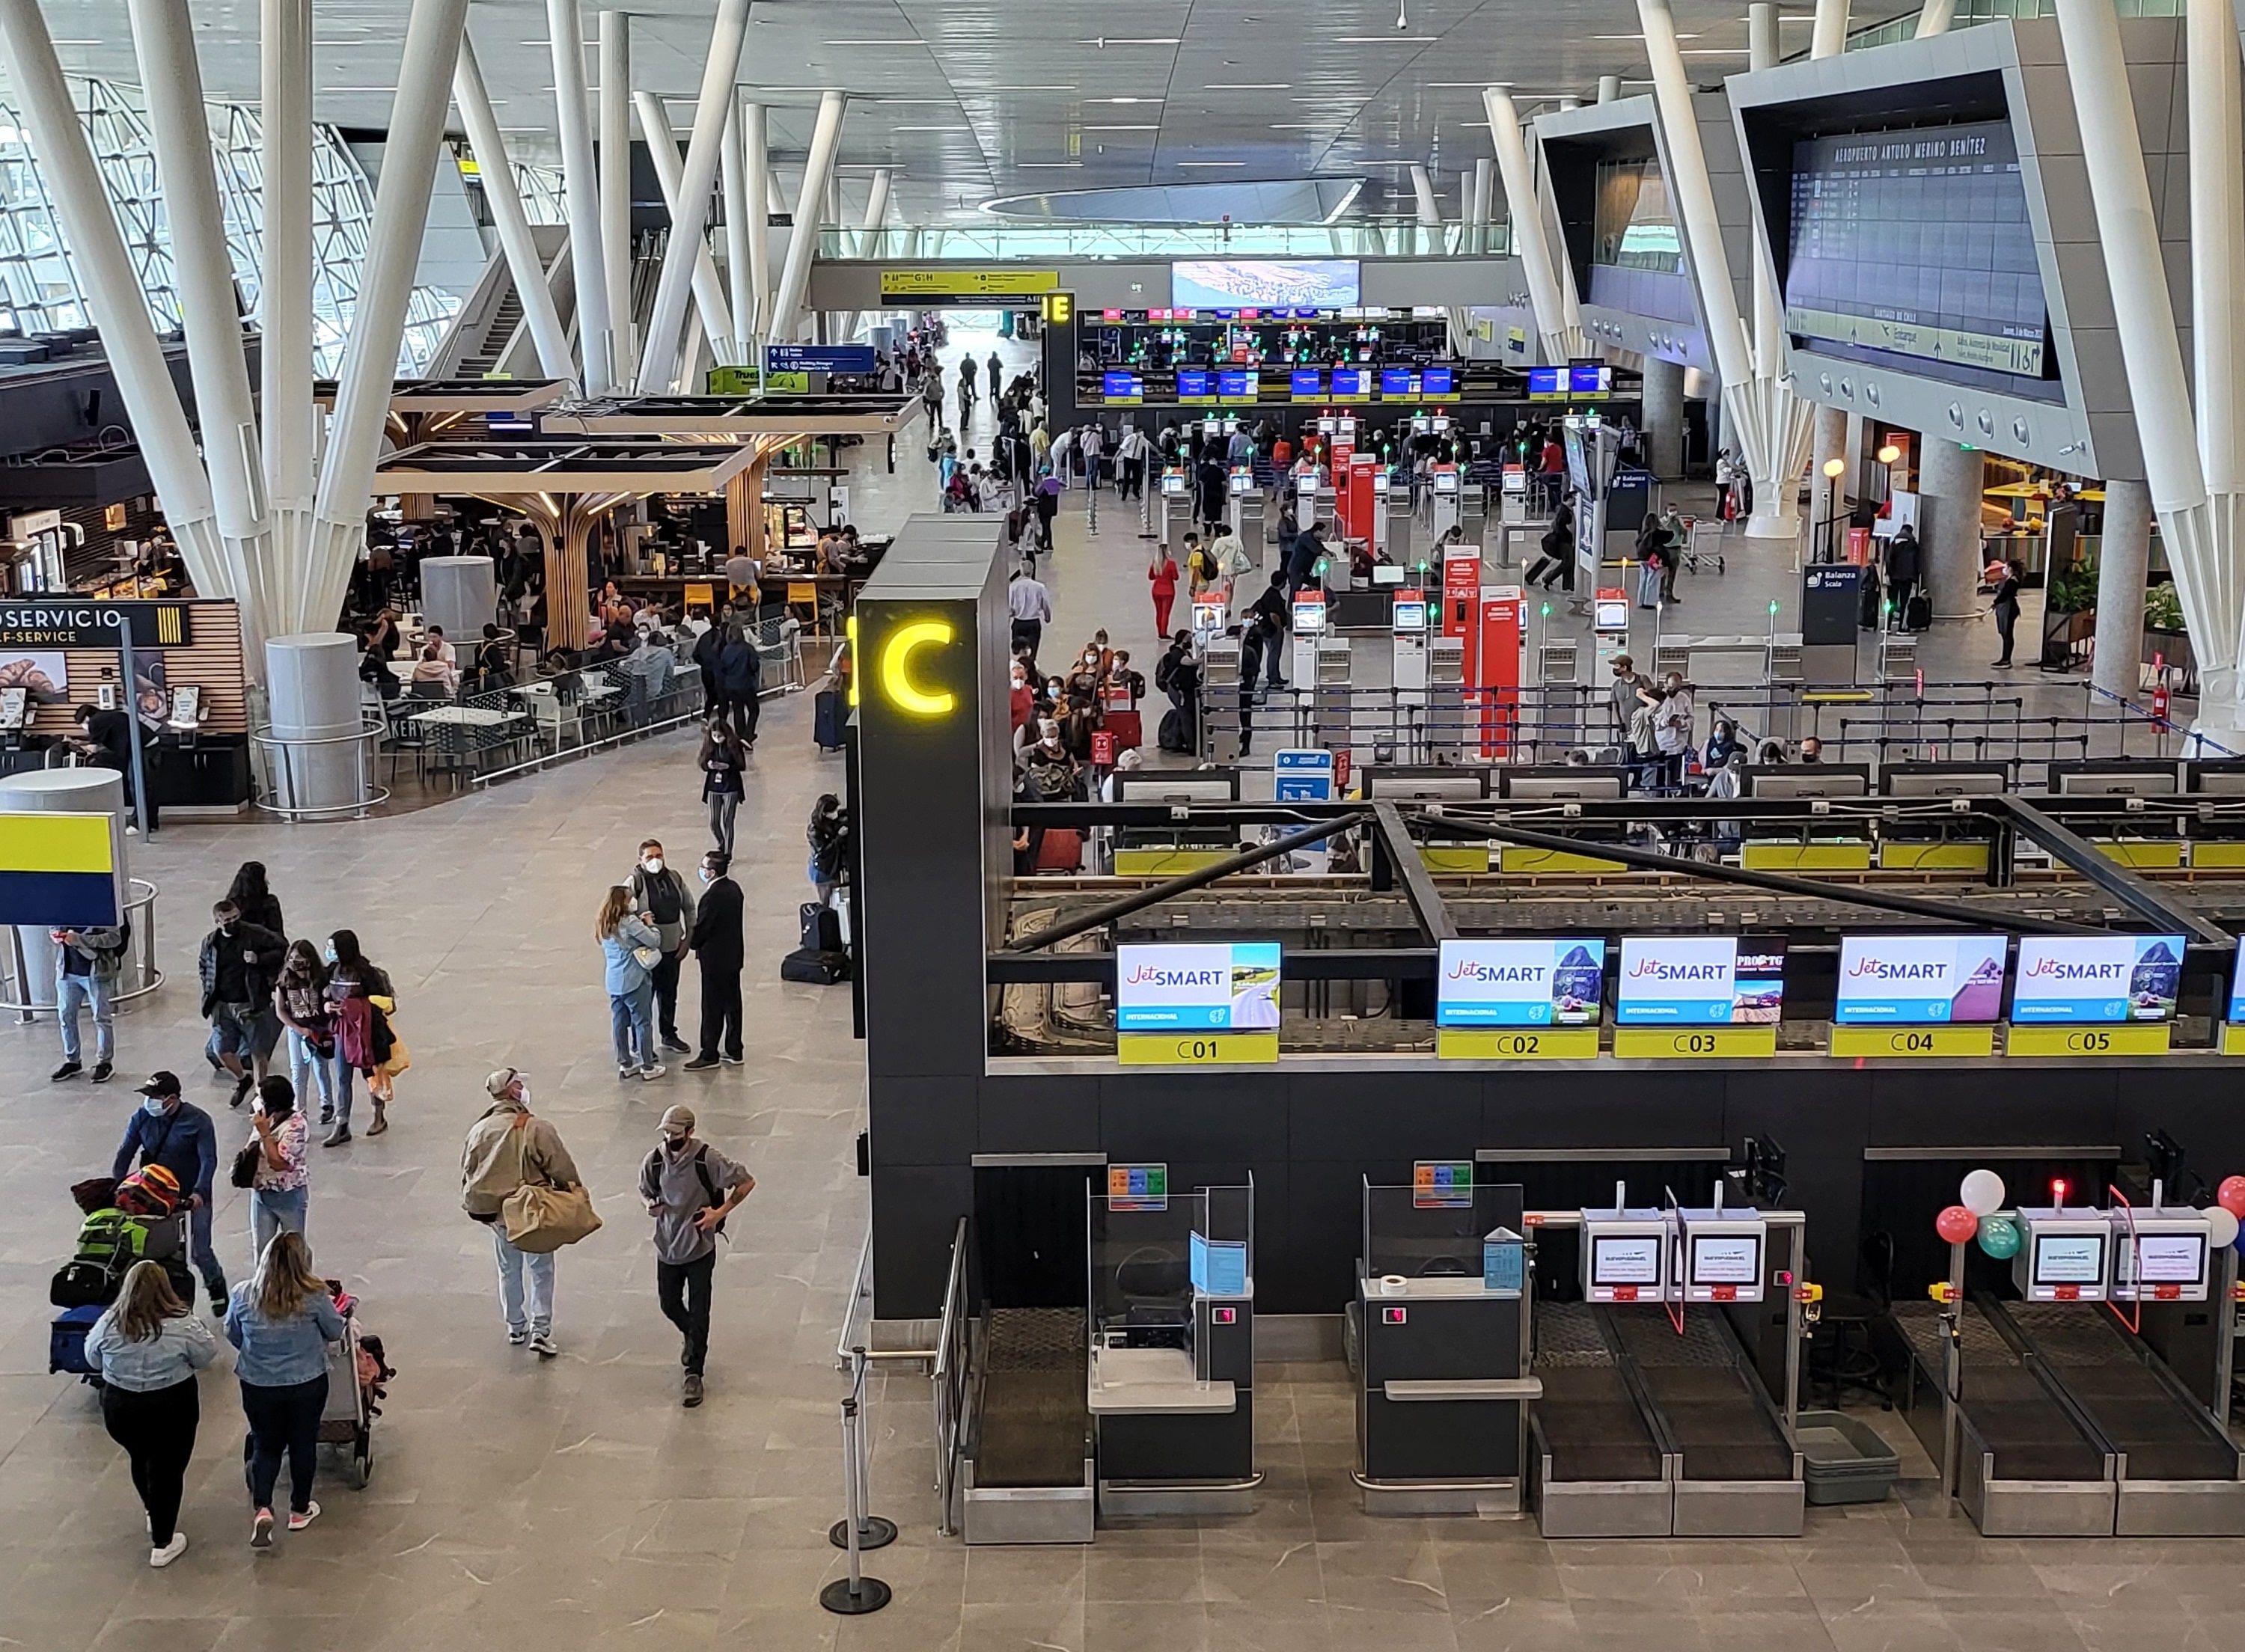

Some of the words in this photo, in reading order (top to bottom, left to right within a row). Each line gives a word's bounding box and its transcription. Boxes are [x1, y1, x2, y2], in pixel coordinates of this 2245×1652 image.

[1835, 144, 1877, 163] AEROPUERTO
[1881, 143, 1910, 160] ARTURO
[1914, 141, 1945, 159] MERINO
[1950, 135, 1985, 157] BENÍTEZ
[1053, 297, 1069, 321] E
[734, 370, 775, 379] TrueSar
[1824, 571, 1856, 579] Balanza
[0, 610, 121, 628] SERVICIO
[0, 631, 76, 643] F-SERVICE
[883, 623, 953, 713] C
[1127, 964, 1224, 986] JetSMART
[1448, 959, 1545, 982] JetSMART
[1628, 958, 1726, 979] JetSMART
[1849, 957, 1948, 979] JetSMART
[2026, 957, 2125, 979] JetSMART
[1177, 1041, 1218, 1059] C01
[1497, 1036, 1539, 1054] C02
[1673, 1035, 1715, 1053] C03
[1891, 1033, 1934, 1051] C04
[2067, 1032, 2110, 1050] C05
